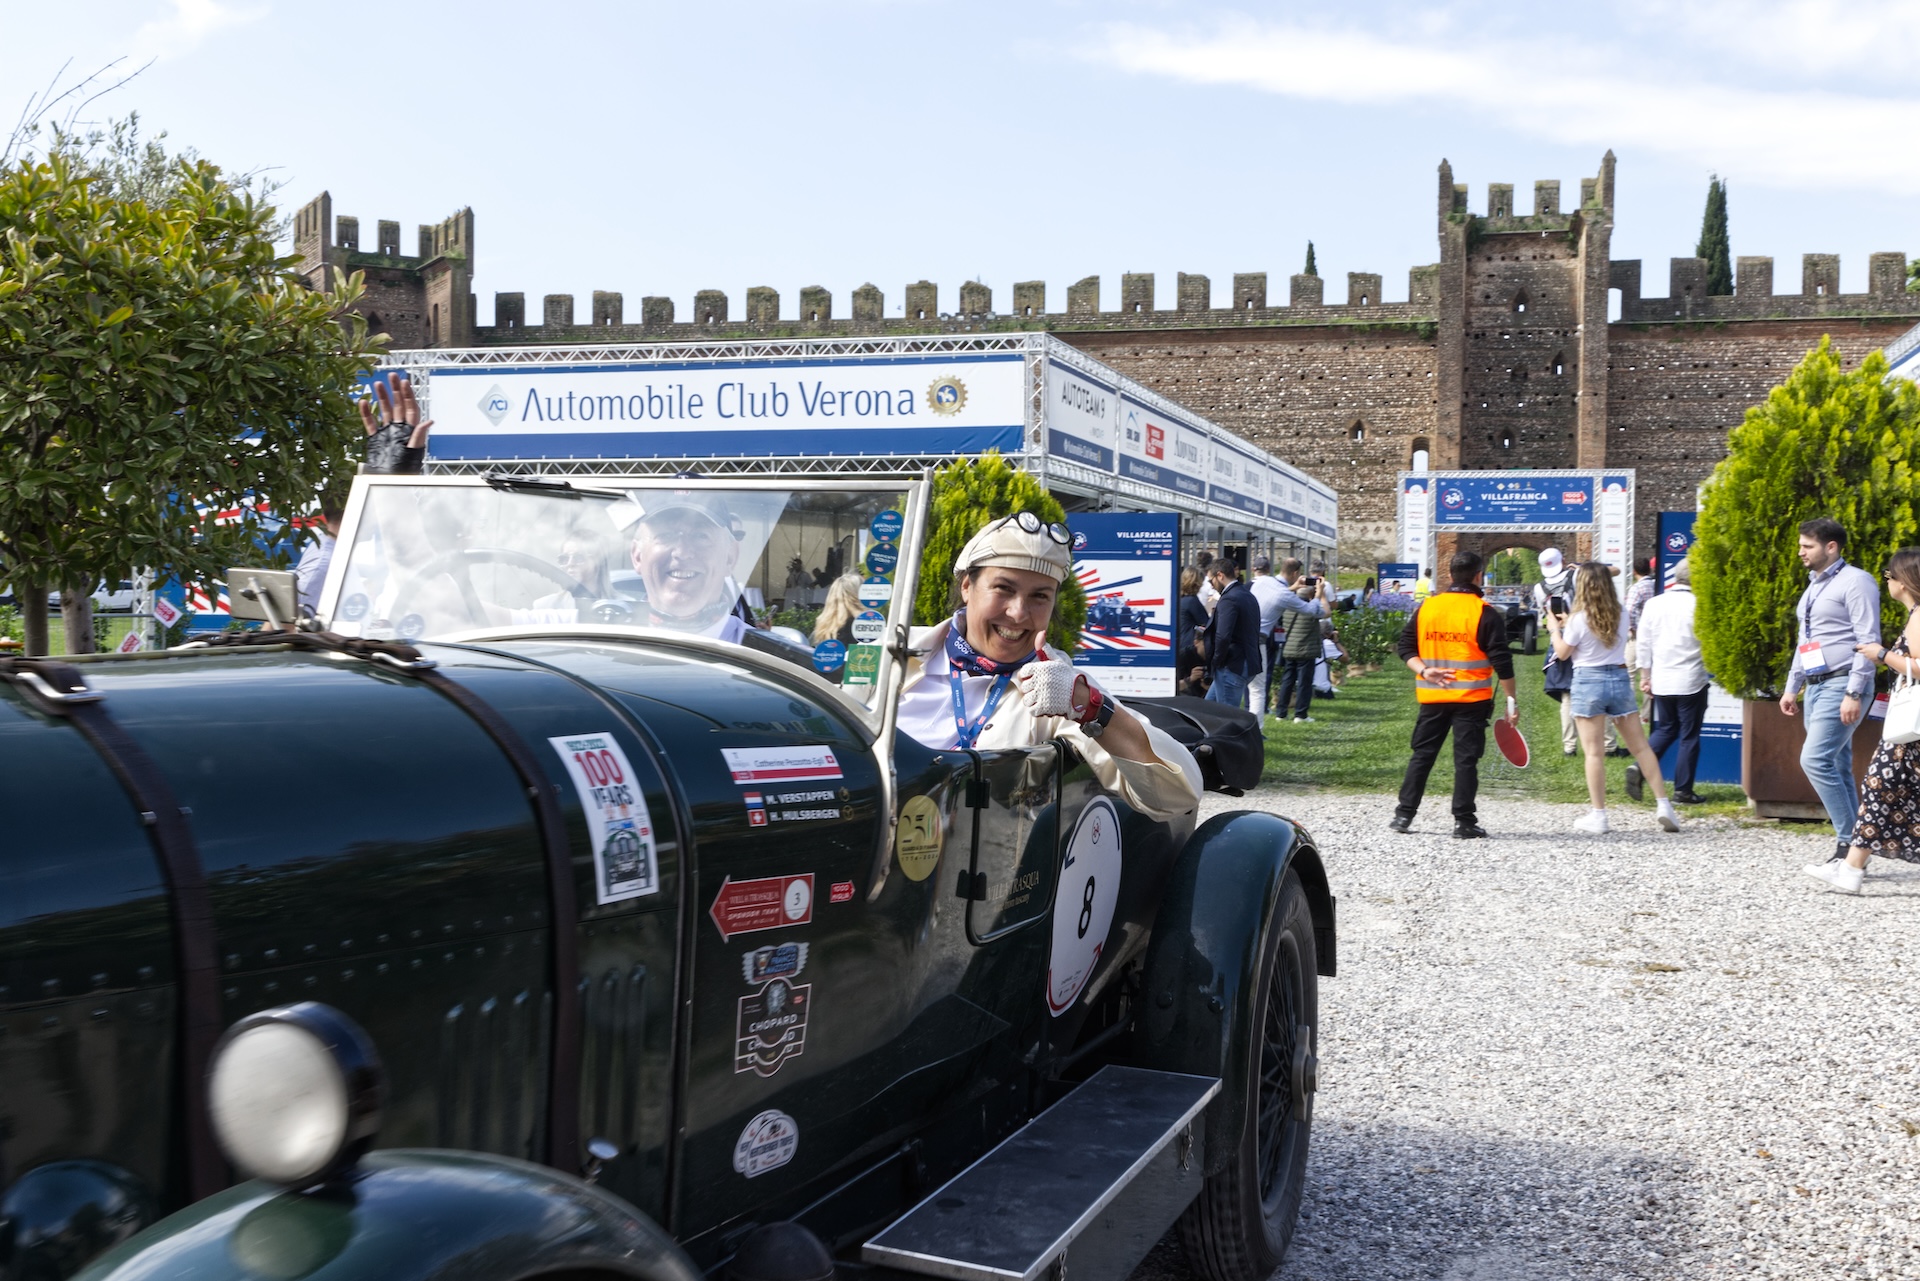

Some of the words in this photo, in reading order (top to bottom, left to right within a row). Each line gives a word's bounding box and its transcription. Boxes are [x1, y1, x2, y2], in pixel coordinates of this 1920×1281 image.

[521, 383, 703, 422] Automobile
[716, 382, 789, 419] Club
[797, 381, 917, 417] Verona
[1061, 380, 1100, 418] AUTOTEAM
[1100, 397, 1106, 420] 9
[1481, 493, 1549, 501] VILLAFRANCA
[1116, 531, 1173, 539] VILLAFRANCA
[855, 624, 883, 632] VERIFICATO
[1425, 631, 1467, 643] ANTINCENDIO
[573, 749, 624, 787] 100
[589, 784, 634, 809] YEARS
[765, 795, 778, 805] M.
[778, 790, 836, 803] VERSTAPPEN
[769, 811, 782, 822] H.
[782, 808, 841, 821] HULSBERGEN
[833, 884, 850, 892] 1000
[1009, 869, 1040, 896] TRASQUA
[729, 894, 749, 904] VILLA
[749, 890, 780, 902] TRASQUA
[793, 892, 801, 907] 3
[727, 910, 760, 920] SPONSOR
[1077, 875, 1096, 940] 8
[748, 1013, 798, 1033] CHOPARD
